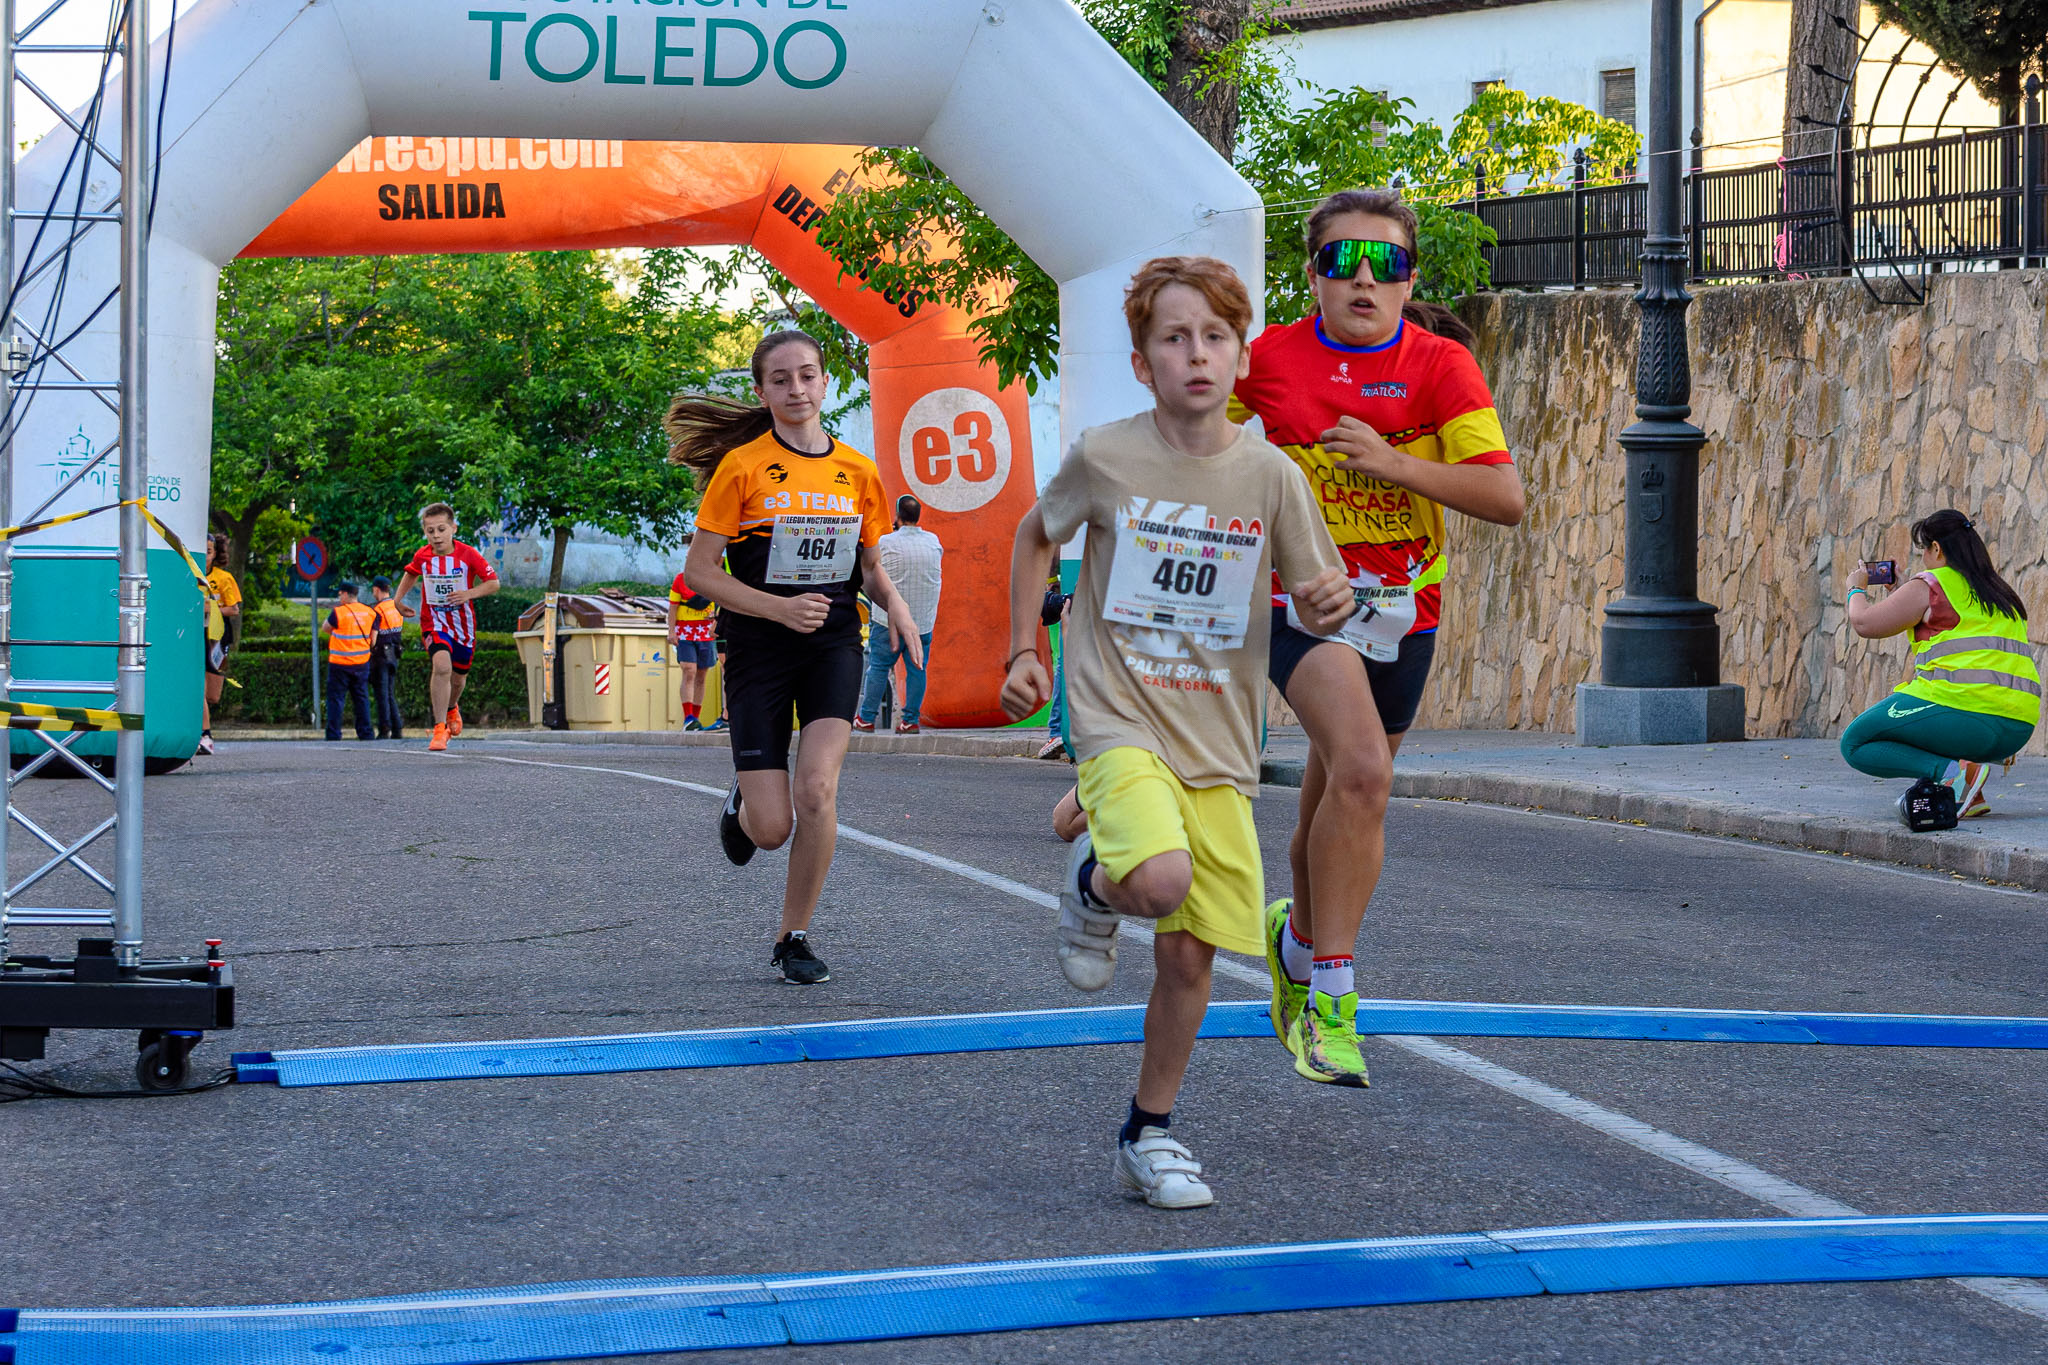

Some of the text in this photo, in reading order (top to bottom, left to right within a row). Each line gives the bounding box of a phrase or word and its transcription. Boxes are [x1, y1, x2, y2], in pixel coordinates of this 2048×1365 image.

[468, 11, 847, 89] TOLEDO
[378, 183, 506, 221] SALIDA
[912, 410, 997, 485] e3
[113, 484, 181, 502] TEDO
[764, 491, 855, 514] e3 TEAM
[1320, 483, 1411, 512] LACASA
[786, 516, 806, 524] LEGUA
[806, 516, 839, 525] NOCTURNA
[1323, 505, 1412, 532] LITNER
[1138, 520, 1169, 535] LEGUA
[1170, 526, 1224, 544] NOCTURNA
[1225, 534, 1257, 547] UGENA
[797, 538, 837, 561] 464
[1152, 558, 1218, 597] 460
[435, 584, 454, 595] 455
[1353, 587, 1381, 599] TURNA
[1125, 655, 1173, 678] PALM
[1143, 675, 1223, 695] CALIFORNIA
